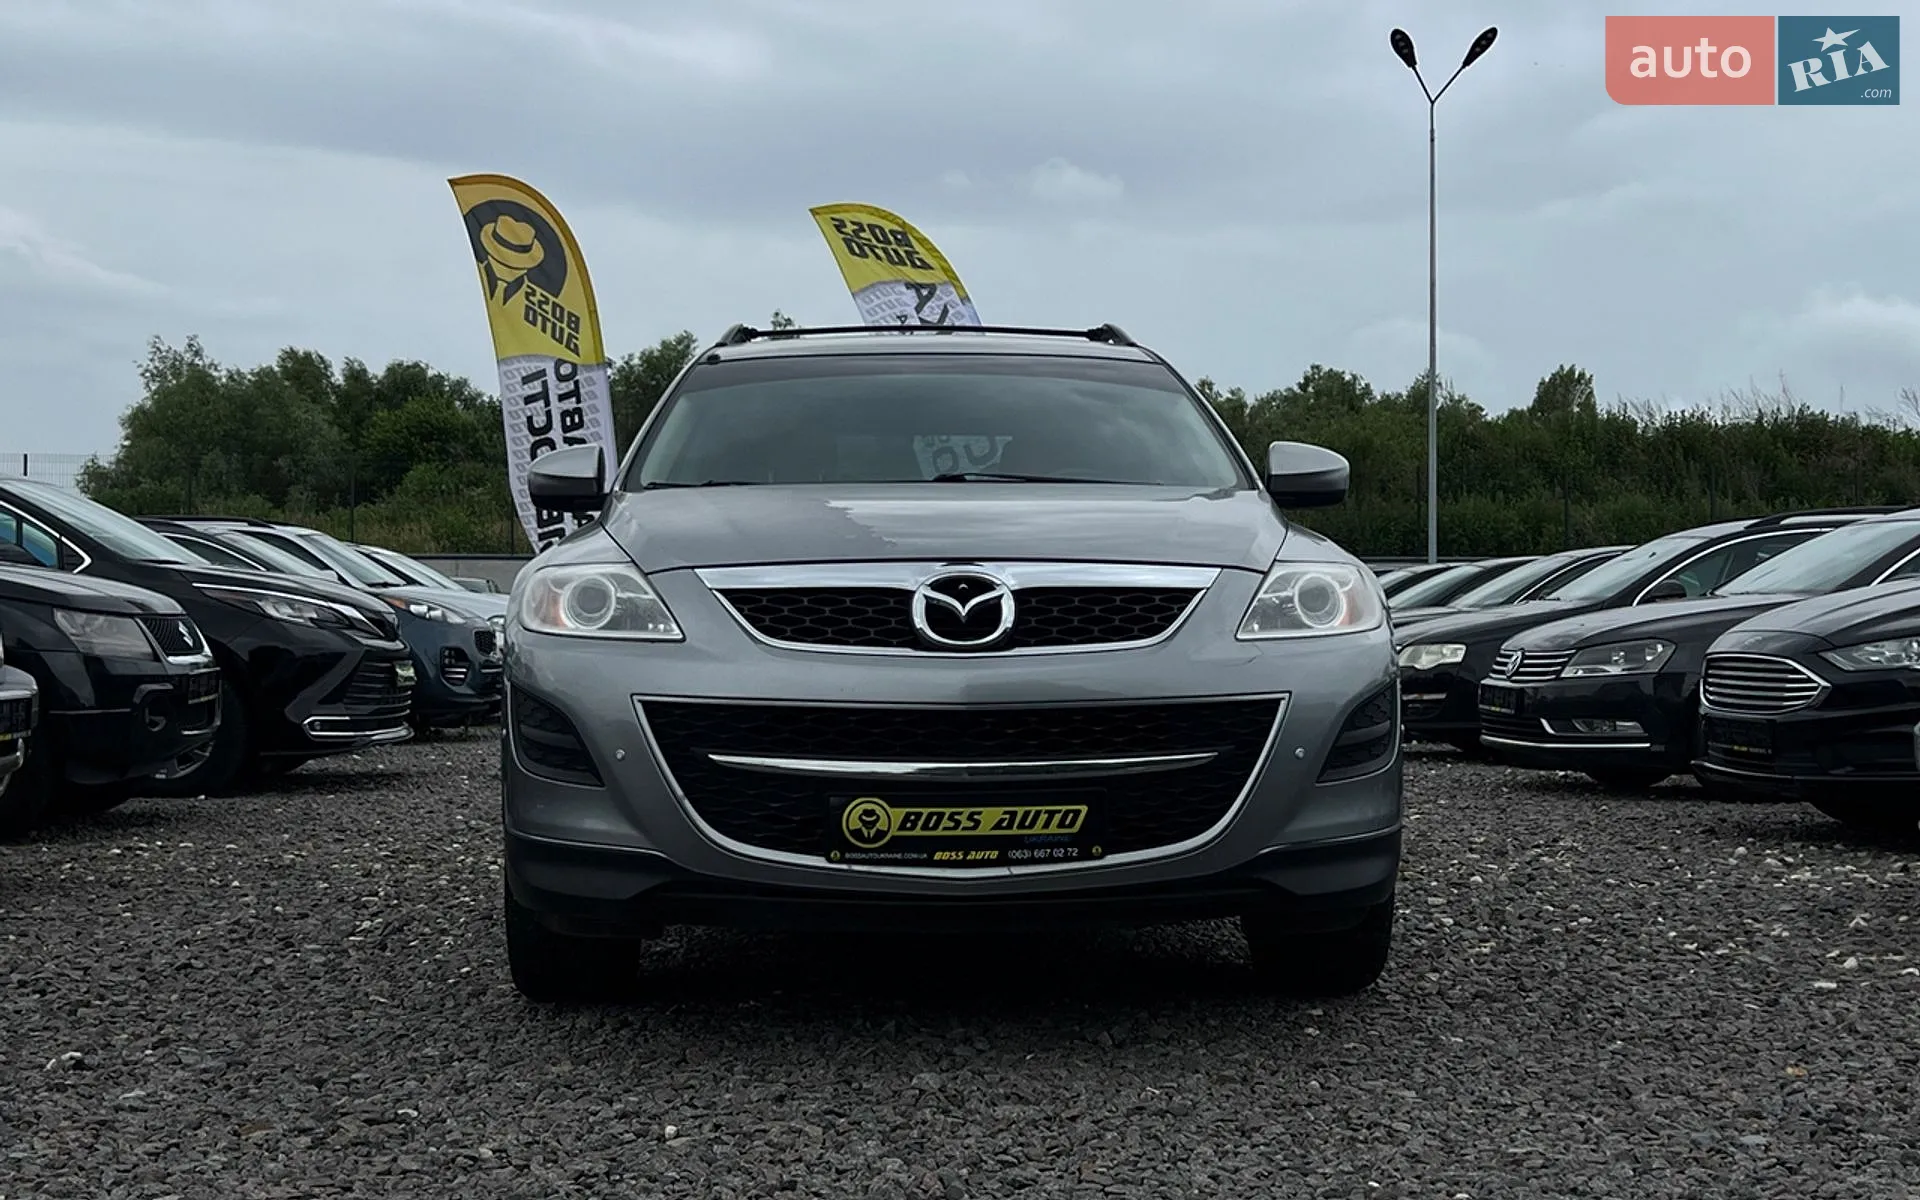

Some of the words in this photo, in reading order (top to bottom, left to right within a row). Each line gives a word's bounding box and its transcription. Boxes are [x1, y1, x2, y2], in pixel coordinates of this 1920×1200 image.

[897, 811, 986, 832] BOSS
[990, 809, 1083, 831] AUTO
[933, 850, 965, 861] BOSS
[966, 850, 999, 861] AUTO
[1052, 848, 1067, 858] 02
[1066, 847, 1080, 857] 72
